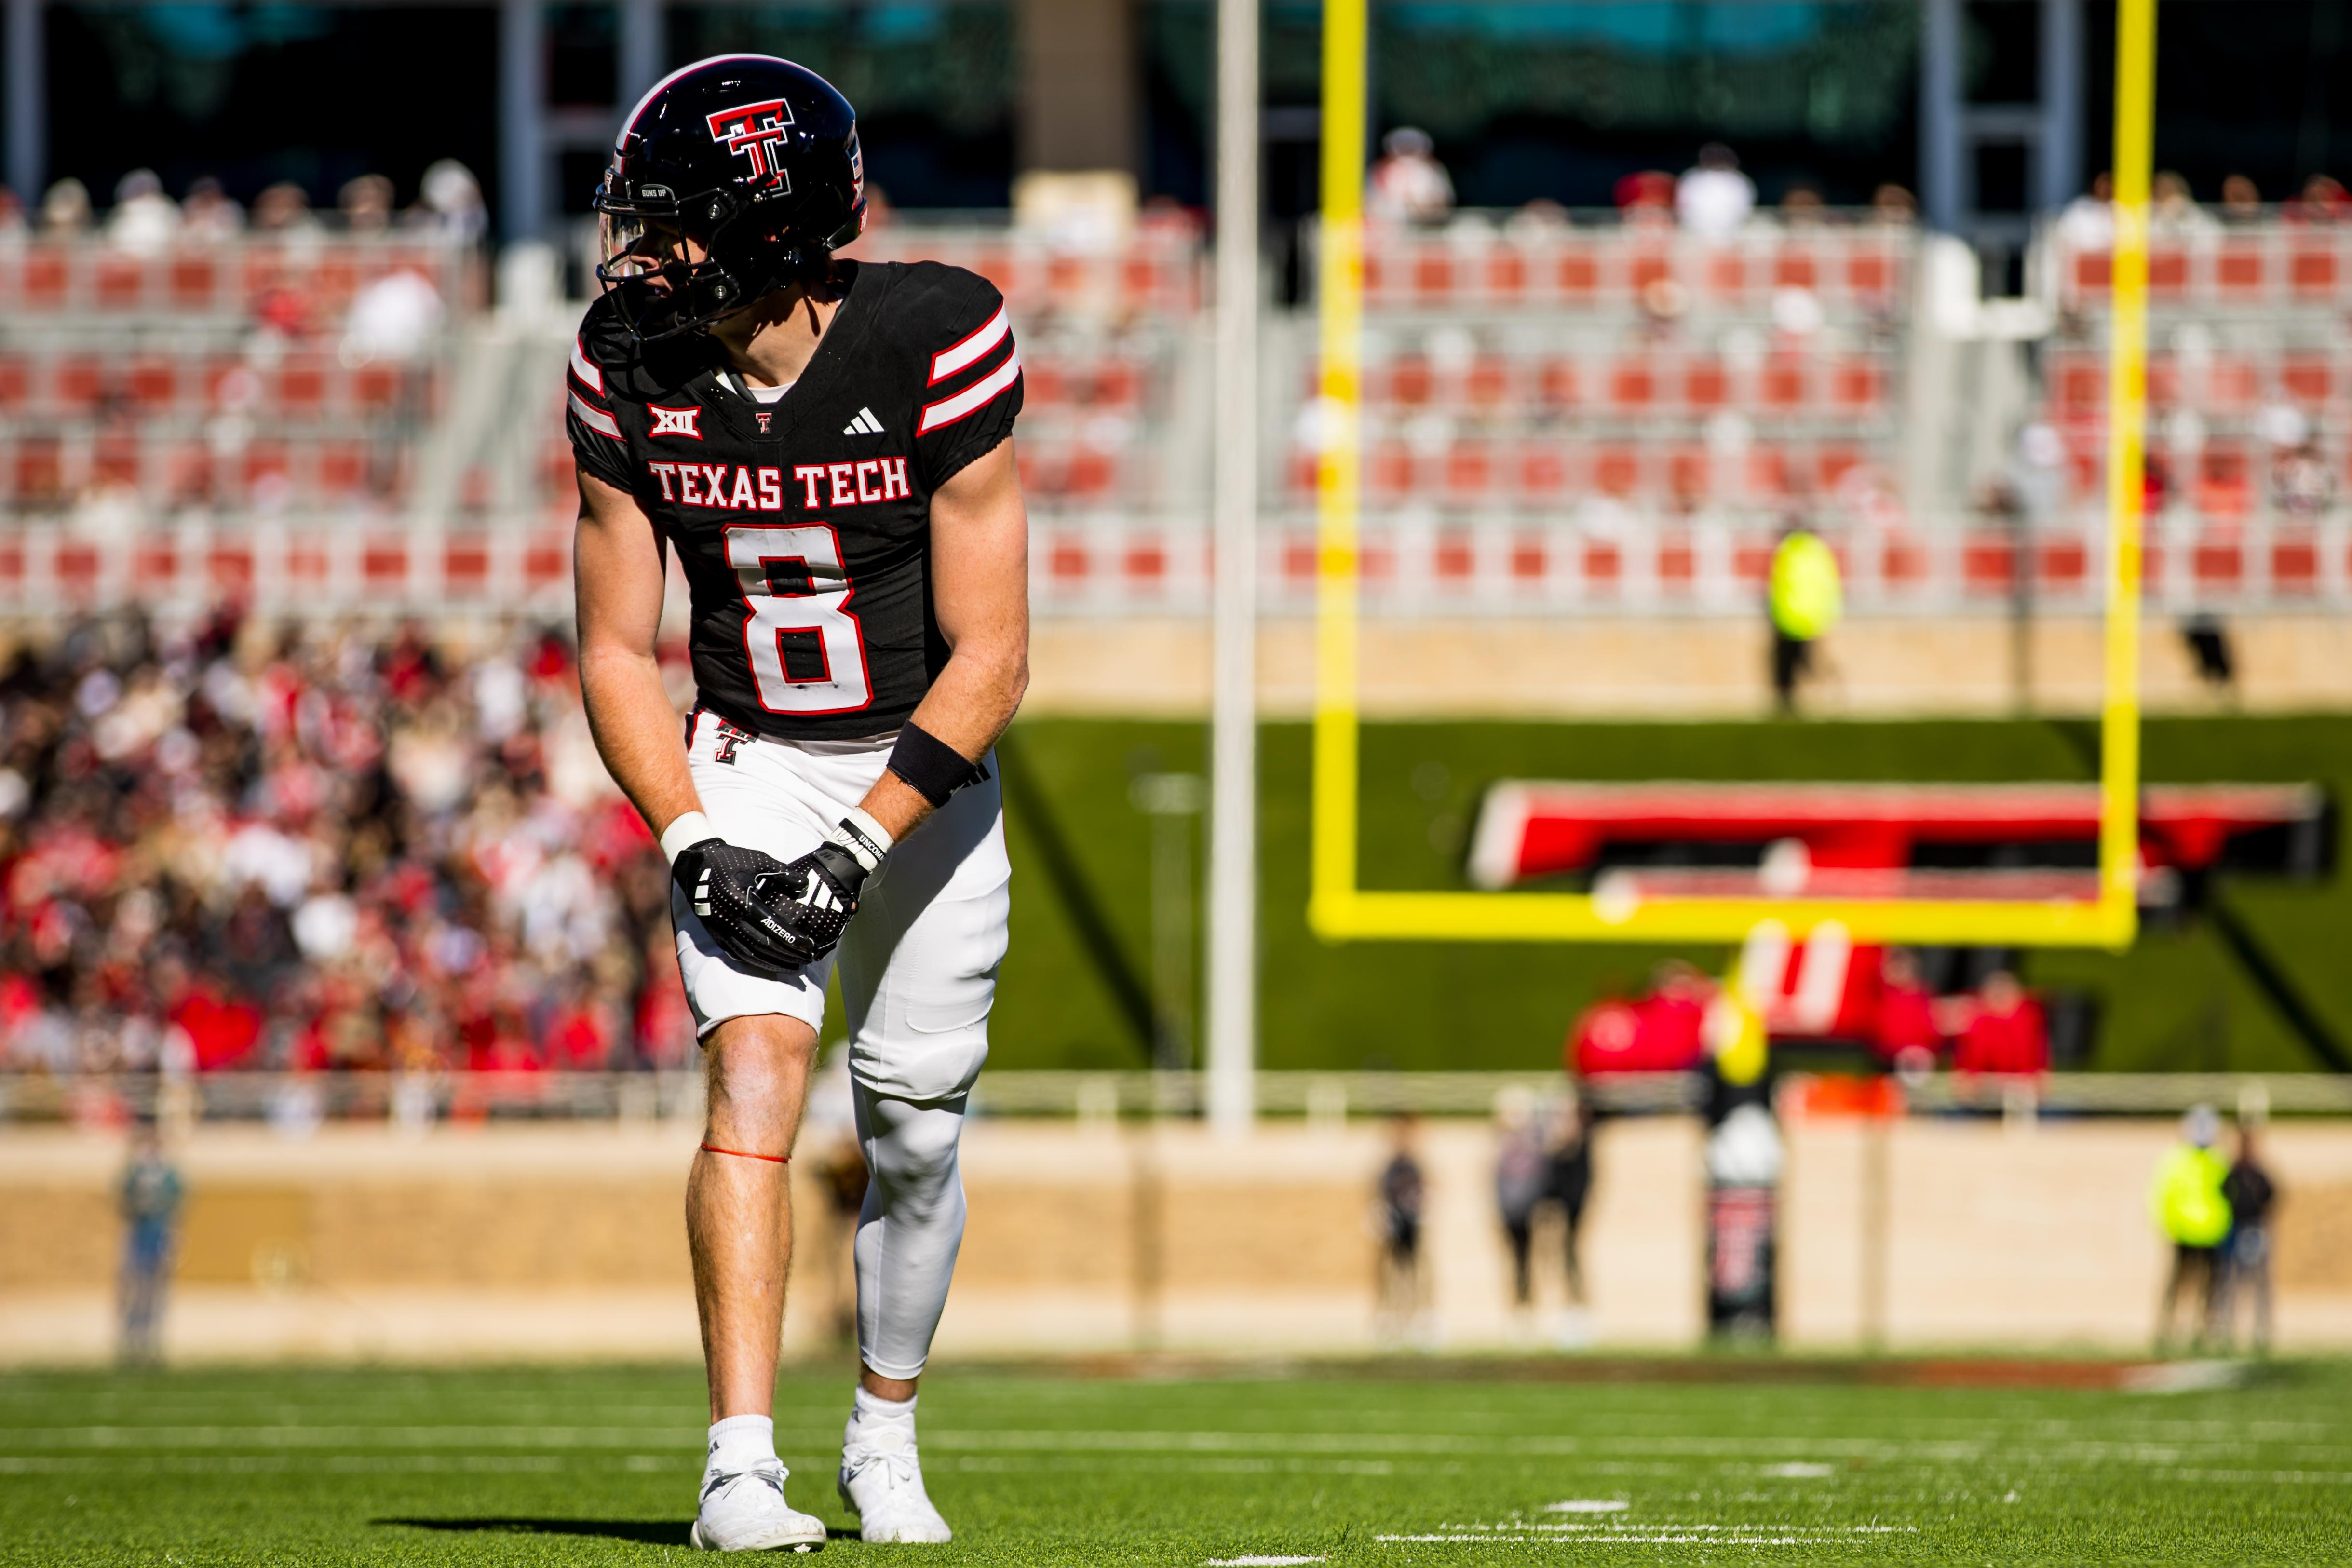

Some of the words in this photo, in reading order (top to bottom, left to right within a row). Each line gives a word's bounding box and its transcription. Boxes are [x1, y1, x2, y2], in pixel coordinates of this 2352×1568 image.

[642, 189, 657, 198] GUNS
[648, 460, 782, 511] TEXAS
[794, 456, 912, 509] TECH
[720, 521, 874, 716] 8
[859, 834, 885, 861] UNCOM
[760, 918, 796, 944] ADIZERO
